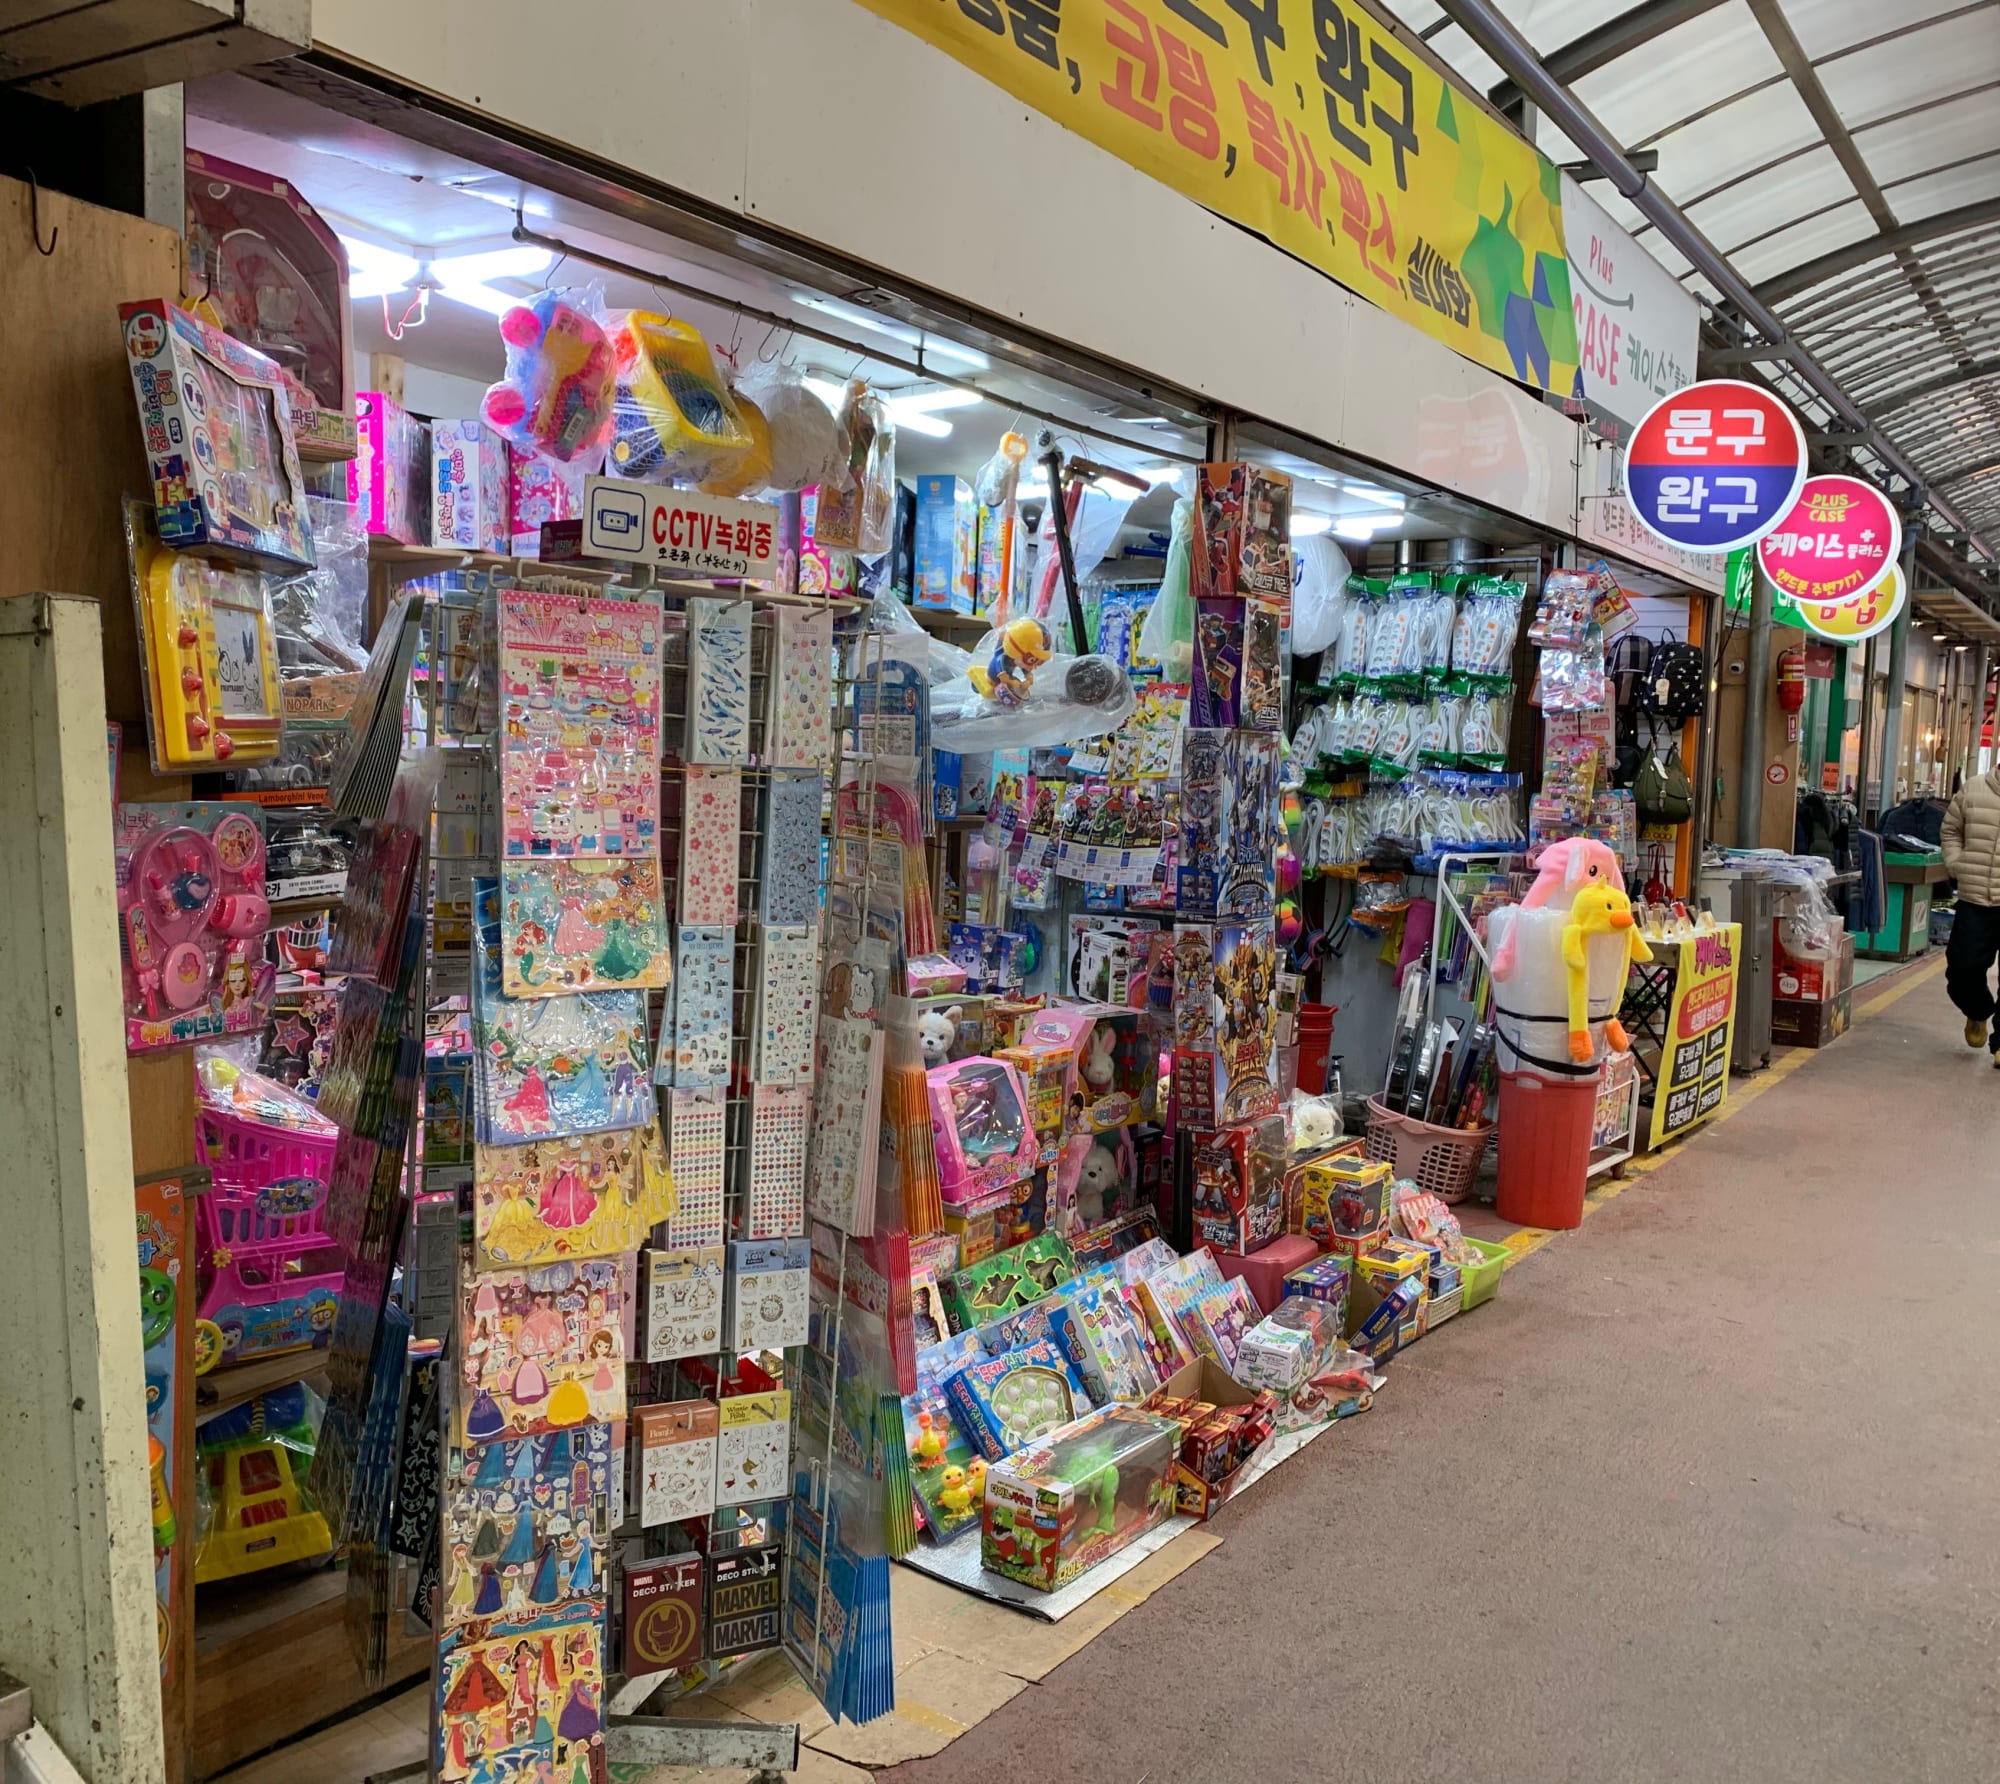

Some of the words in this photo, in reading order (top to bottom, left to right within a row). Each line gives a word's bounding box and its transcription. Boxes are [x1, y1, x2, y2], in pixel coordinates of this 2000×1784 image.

[1312, 0, 1420, 192] 완구
[1589, 234, 1614, 285] Plus
[1407, 235, 1471, 328] 실내화
[1627, 333, 1667, 397] 케이스
[1664, 408, 1765, 457] 문구
[1657, 476, 1759, 524] 완구
[1811, 493, 1849, 507] PLUS
[1809, 510, 1846, 523] CASE
[1765, 532, 1844, 559] 케이스
[1393, 577, 1412, 588] dosel
[1478, 585, 1499, 595] dosel
[1359, 685, 1382, 697] dosel
[1470, 777, 1492, 786] dosel
[258, 792, 305, 803] Lamborghini
[717, 1571, 739, 1583] DECO
[633, 1587, 657, 1598] DECO
[715, 1580, 777, 1617] MARVEL
[715, 1614, 776, 1650] MARVEL
